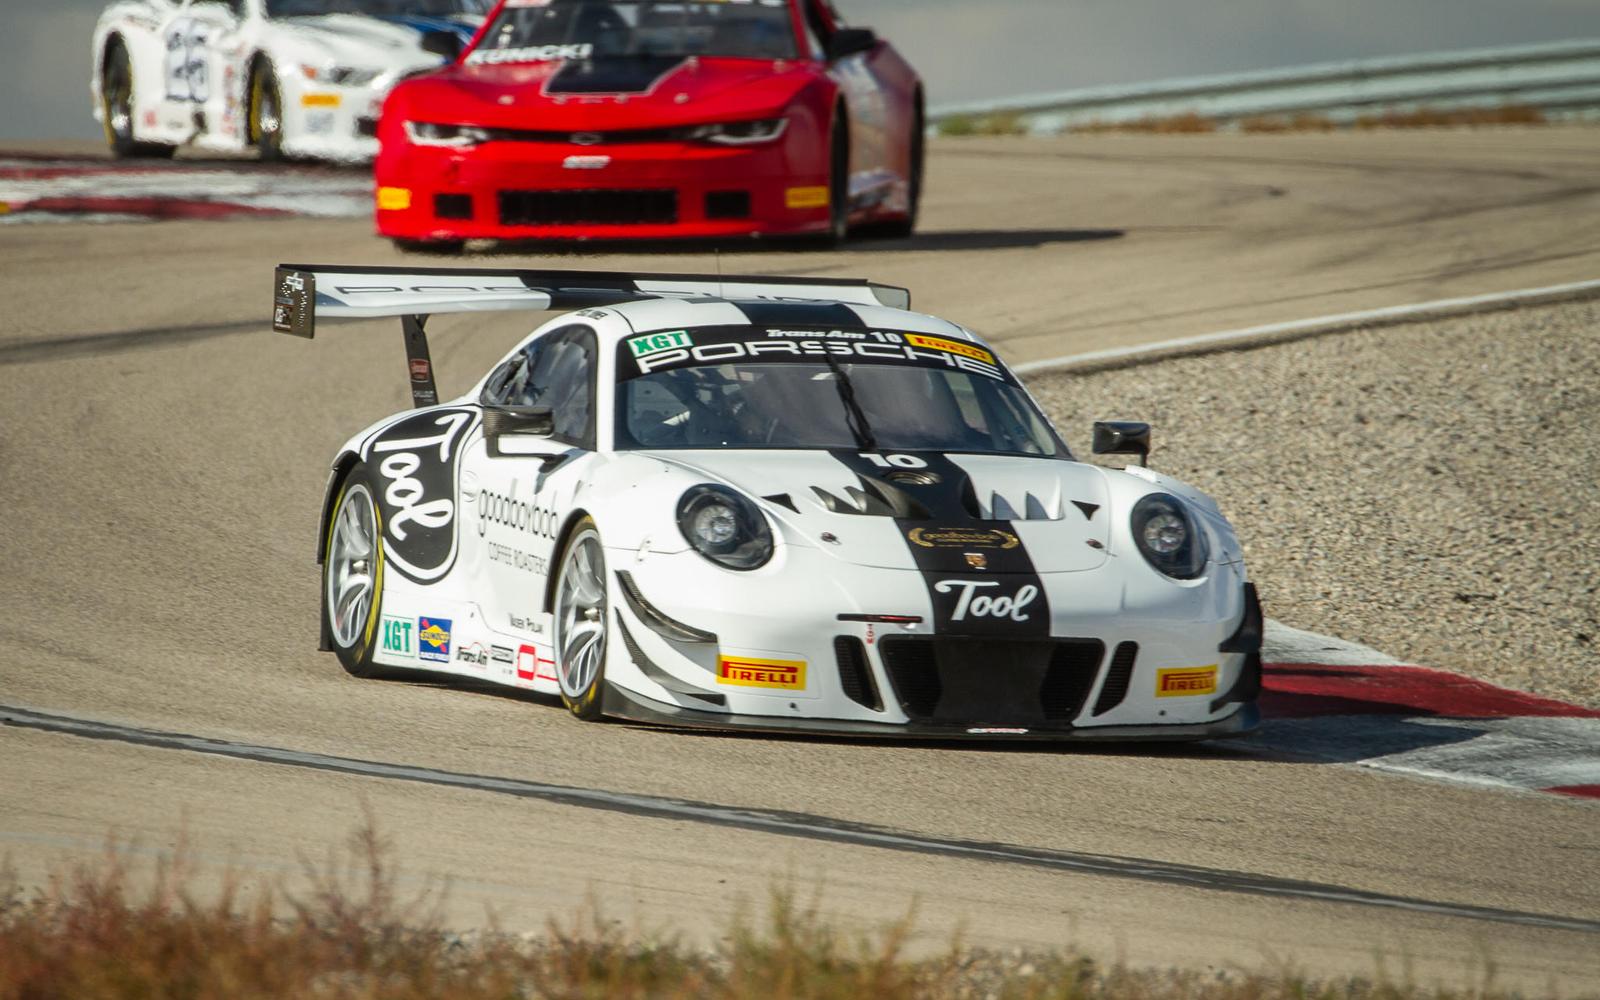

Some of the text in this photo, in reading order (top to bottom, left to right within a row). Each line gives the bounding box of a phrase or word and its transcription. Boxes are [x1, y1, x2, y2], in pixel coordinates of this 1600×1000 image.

[634, 332, 685, 354] XGT
[766, 329, 902, 343] Trans Am 10
[635, 340, 1004, 381] PORSCHE
[858, 453, 928, 468] 10
[373, 412, 471, 541] Tool
[934, 580, 1038, 622] Tool
[383, 619, 412, 653] XGT
[722, 661, 798, 684] PIRELLI
[1161, 671, 1214, 692] PIRELLI
